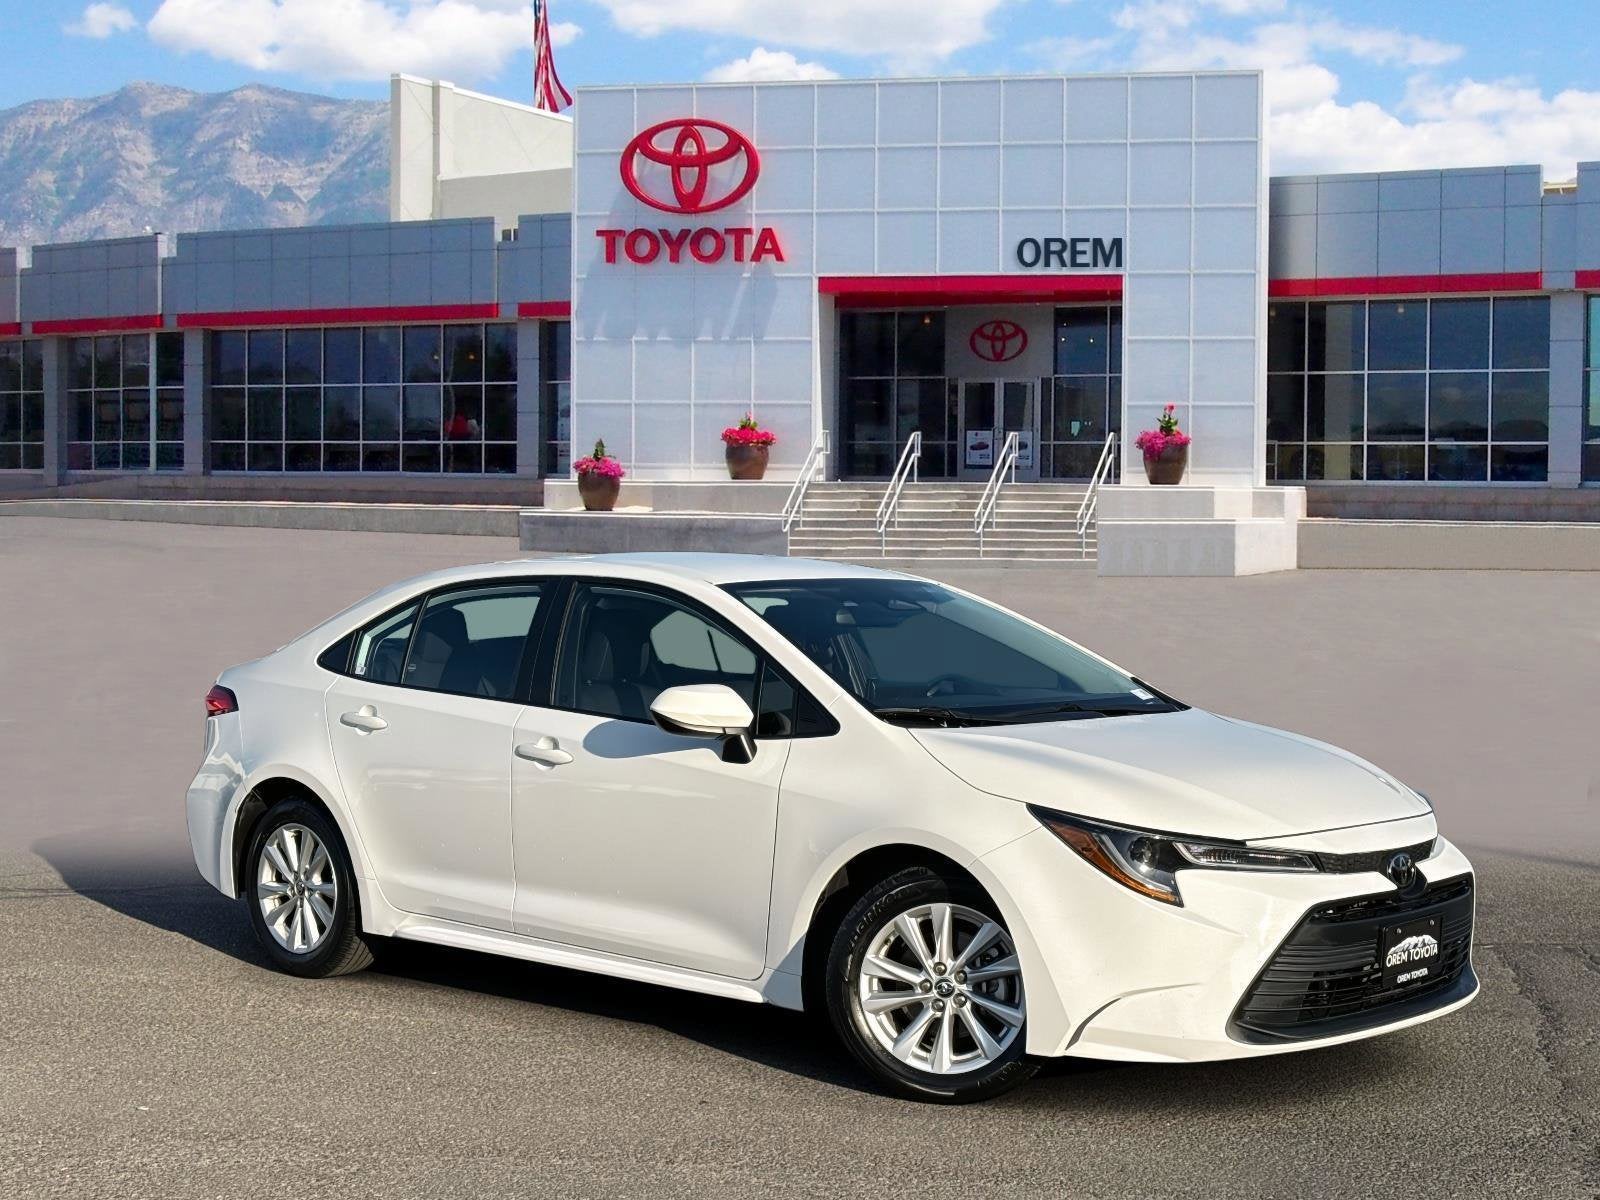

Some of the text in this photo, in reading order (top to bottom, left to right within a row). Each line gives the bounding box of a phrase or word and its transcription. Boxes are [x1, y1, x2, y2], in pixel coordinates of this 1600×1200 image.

[596, 227, 785, 264] TOYOTA
[1016, 237, 1123, 268] OREM
[1386, 944, 1438, 967] OREM TOYOTA
[1397, 973, 1411, 983] OREM
